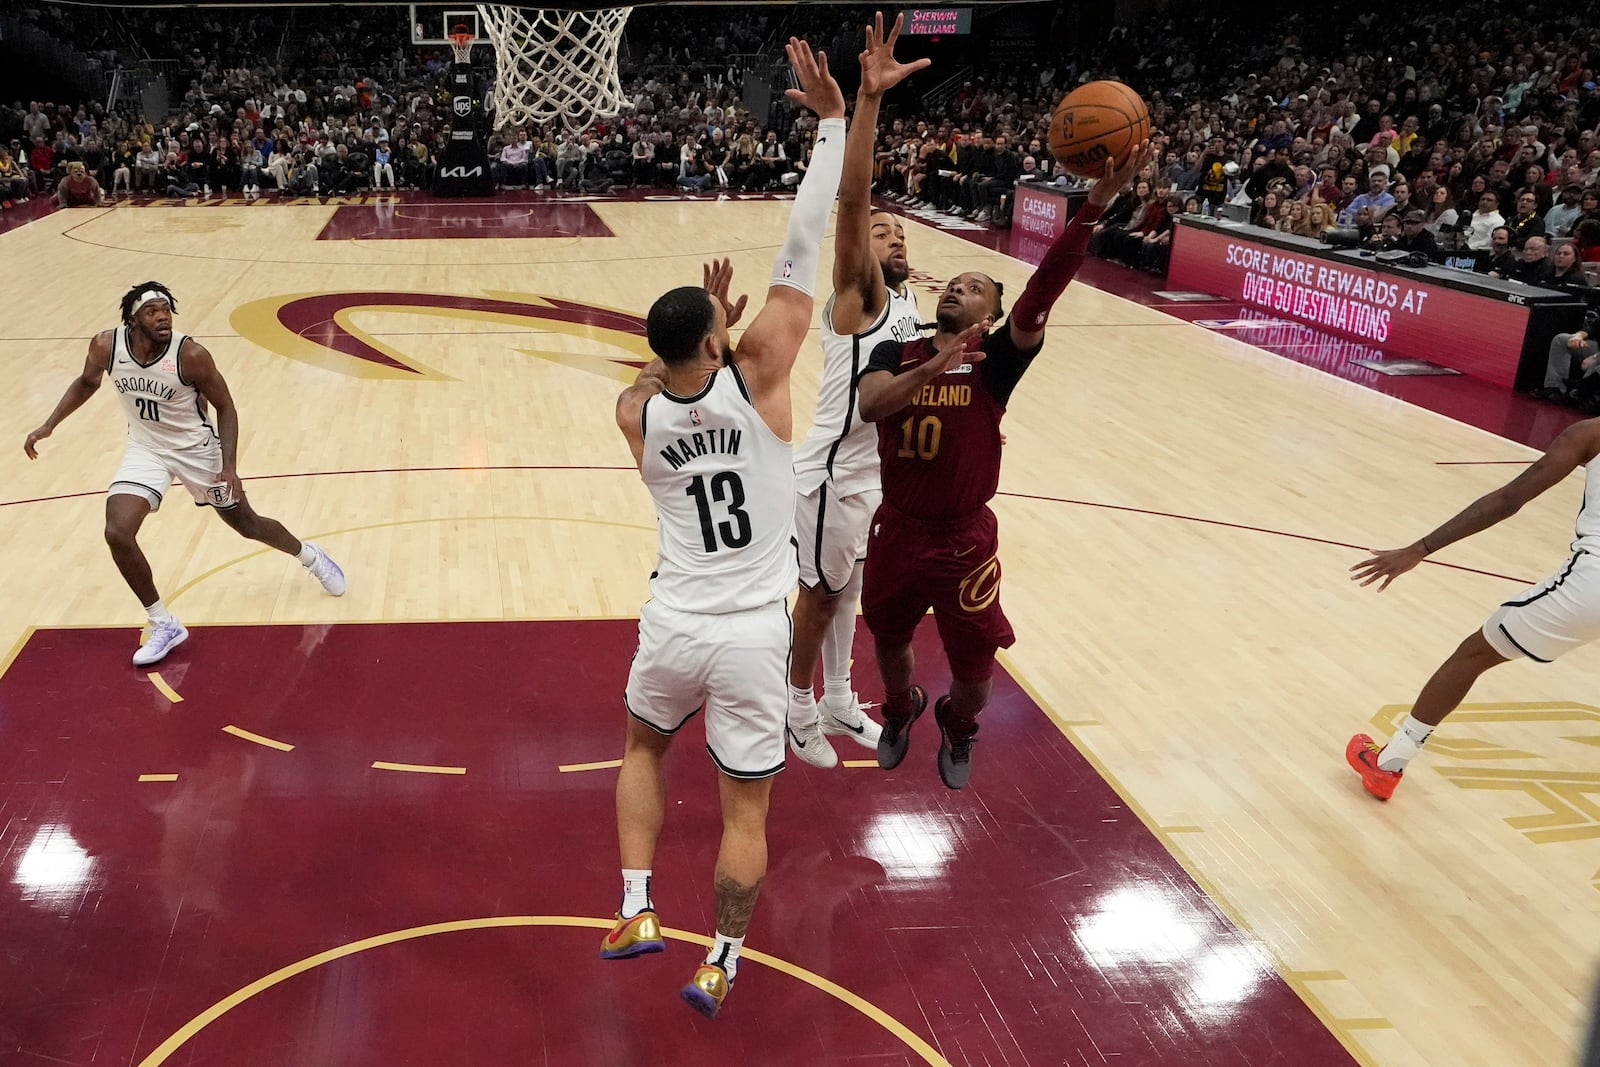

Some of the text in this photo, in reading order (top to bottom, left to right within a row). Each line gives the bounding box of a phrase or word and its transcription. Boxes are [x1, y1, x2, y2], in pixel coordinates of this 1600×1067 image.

[912, 10, 958, 21] SHERWIN
[910, 23, 957, 34] WILLIAMS
[456, 102, 470, 113] ups
[1023, 196, 1056, 220] CAESARS
[1022, 215, 1054, 238] REWARDS
[1226, 244, 1428, 315] SCORE MORE REWARDS AT
[1242, 271, 1391, 343] OVER 50 DESTINATIONS
[114, 377, 177, 400] BROOKLYN
[135, 397, 160, 422] 20
[659, 428, 742, 471] MARTIN
[897, 415, 942, 461] 10
[685, 471, 753, 553] 13
